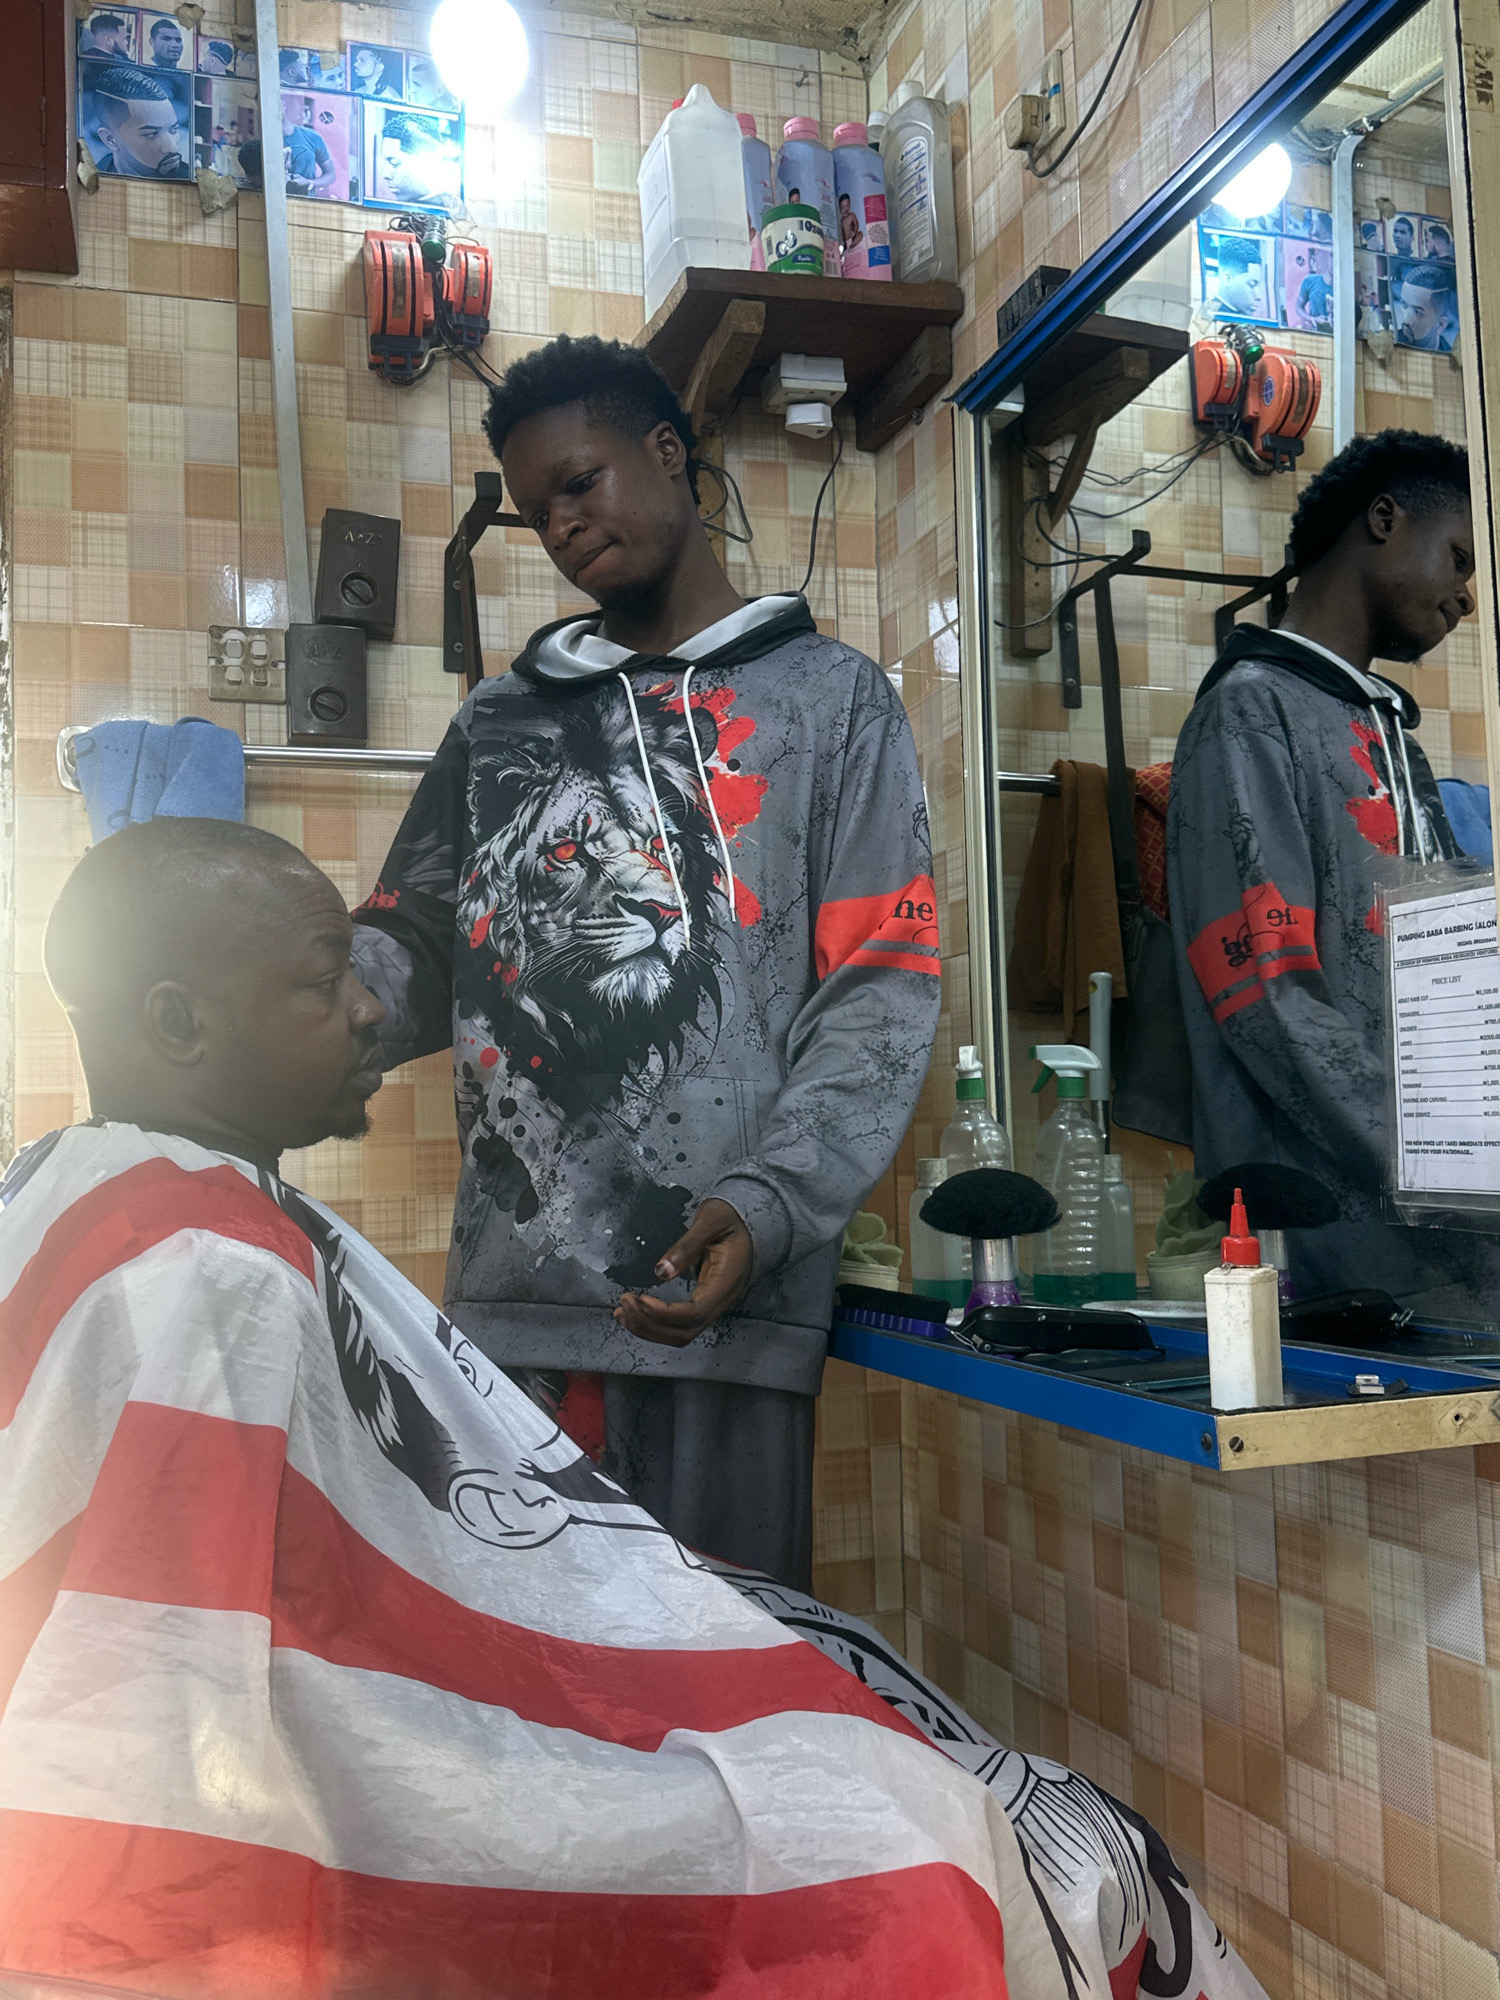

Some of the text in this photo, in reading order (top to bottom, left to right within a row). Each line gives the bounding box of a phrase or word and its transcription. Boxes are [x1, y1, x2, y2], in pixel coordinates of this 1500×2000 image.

[1397, 920, 1497, 942] PUMPING BABA BARBING SALON
[1432, 975, 1461, 985] PRICE LIST
